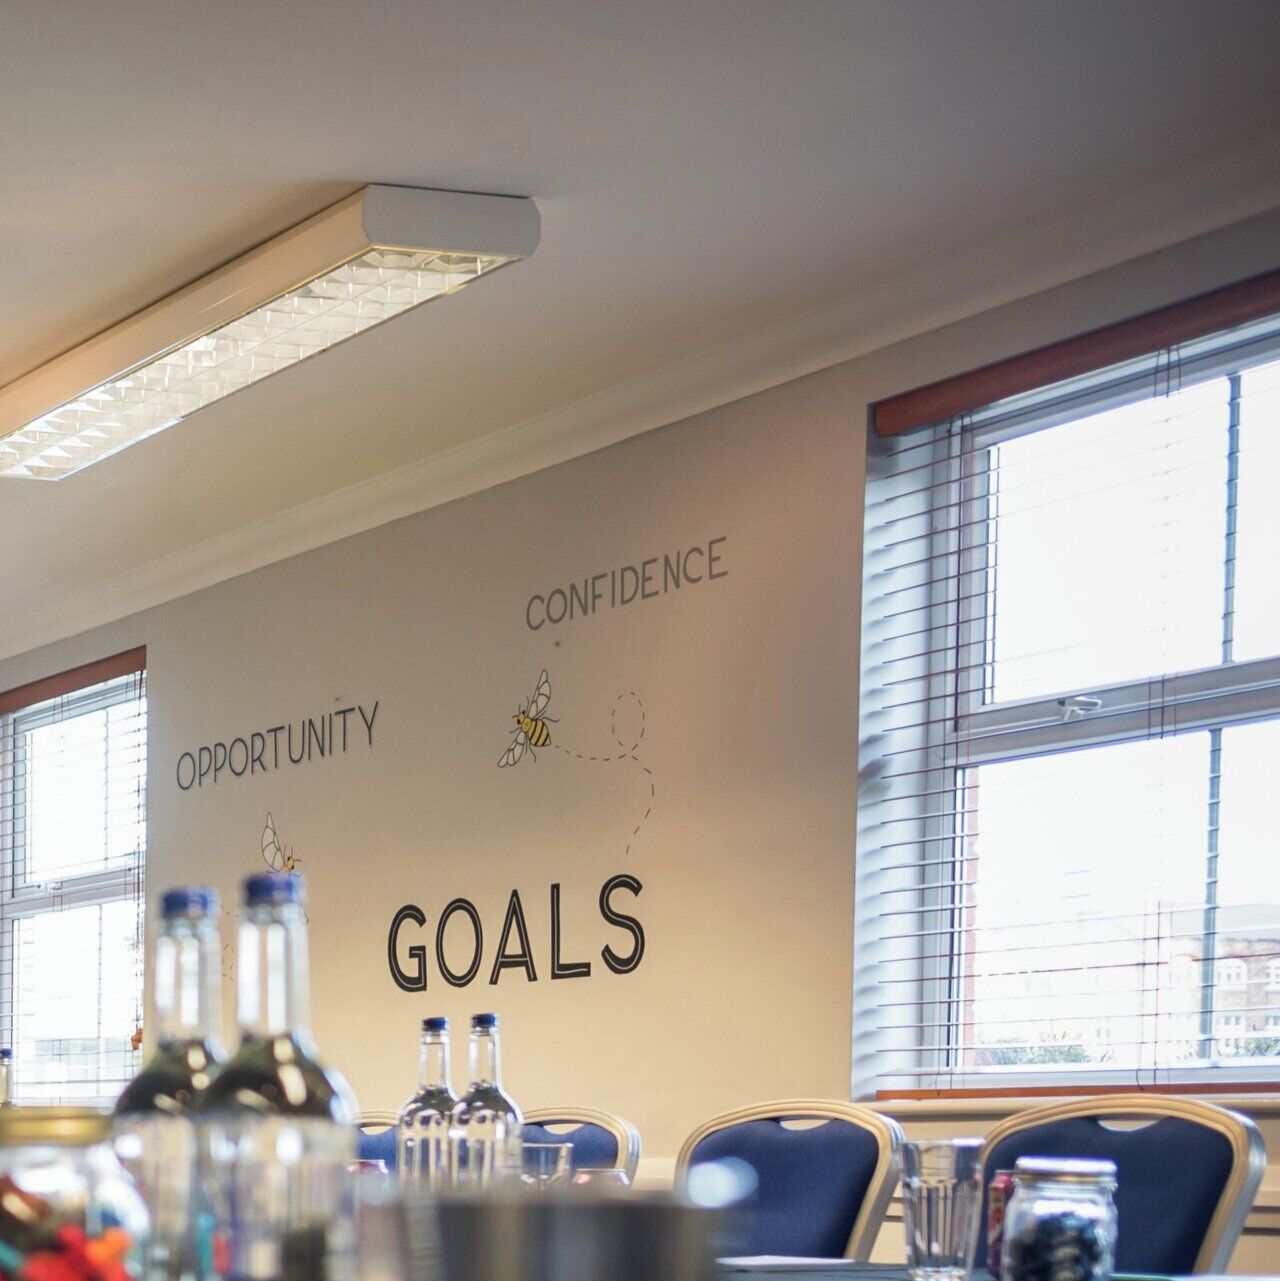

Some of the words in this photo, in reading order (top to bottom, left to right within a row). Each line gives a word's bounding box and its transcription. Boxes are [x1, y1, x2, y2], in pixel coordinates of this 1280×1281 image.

[526, 537, 729, 631] CONFIDENCE
[177, 701, 379, 791] OPPORTUNITY
[387, 874, 646, 993] GOALS
